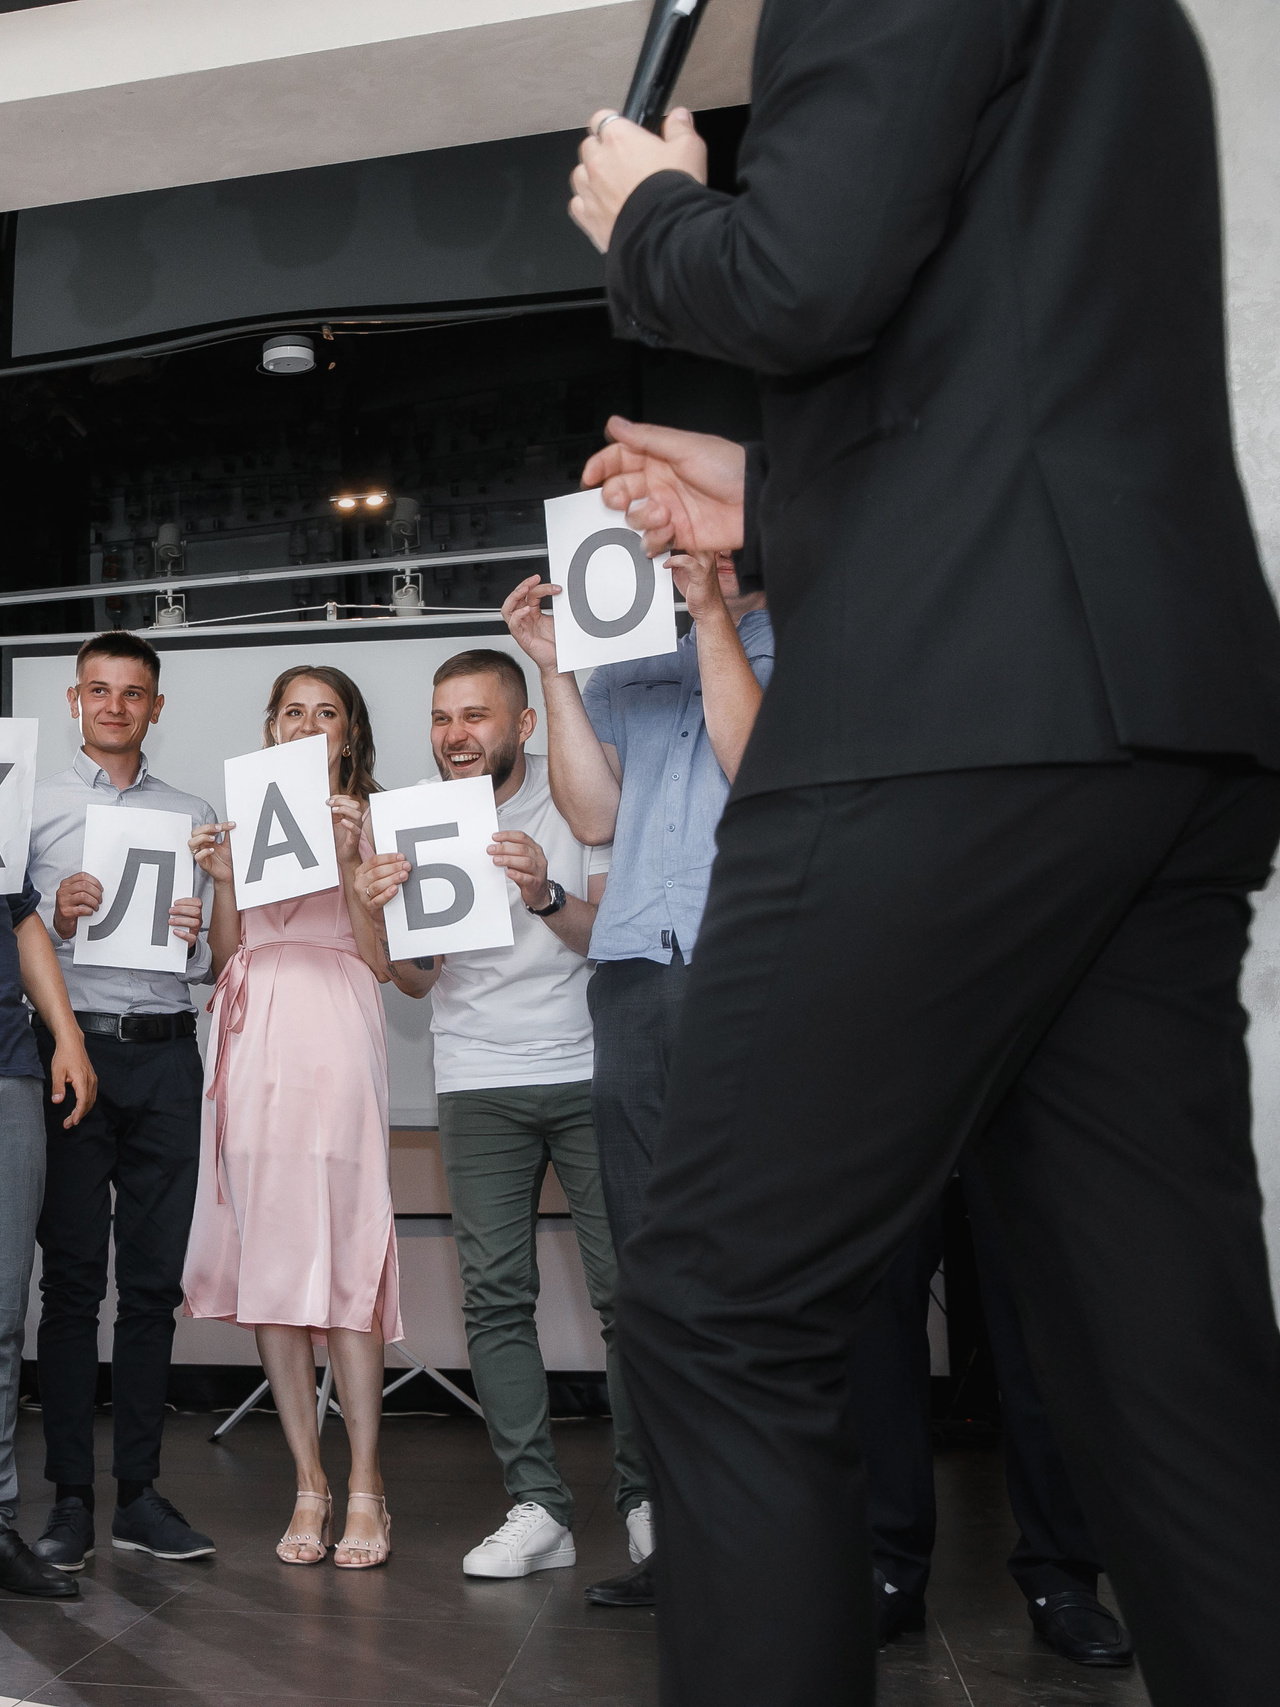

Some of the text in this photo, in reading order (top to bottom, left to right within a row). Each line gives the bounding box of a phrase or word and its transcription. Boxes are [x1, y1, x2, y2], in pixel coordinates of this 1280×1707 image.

[567, 527, 656, 639] О
[244, 782, 319, 885] А
[394, 821, 475, 931] Б
[87, 847, 176, 946] Л
